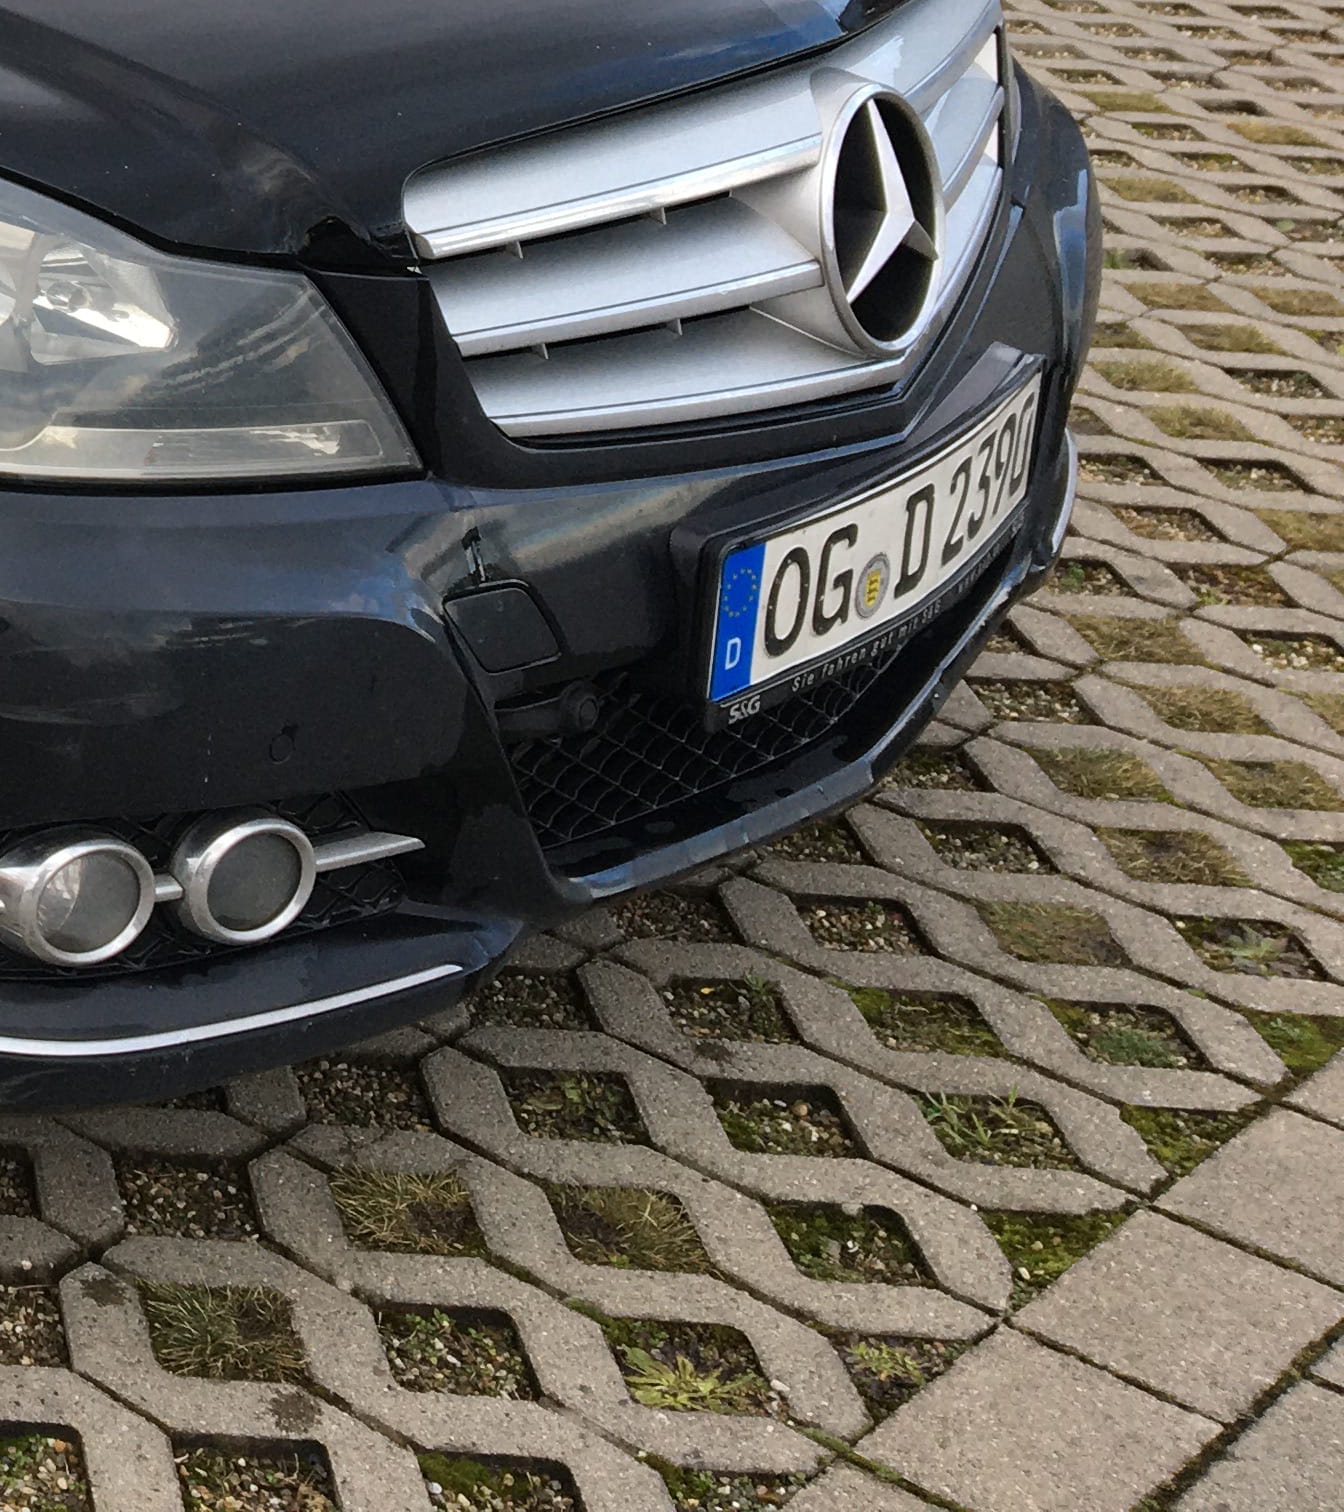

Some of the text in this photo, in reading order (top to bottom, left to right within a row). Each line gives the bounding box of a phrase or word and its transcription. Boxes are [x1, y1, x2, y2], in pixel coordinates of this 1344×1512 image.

[764, 392, 1035, 658] OG D 2390
[725, 638, 742, 670] D
[791, 672, 815, 692] Sie
[821, 647, 866, 679] fahren
[870, 632, 894, 657] gut
